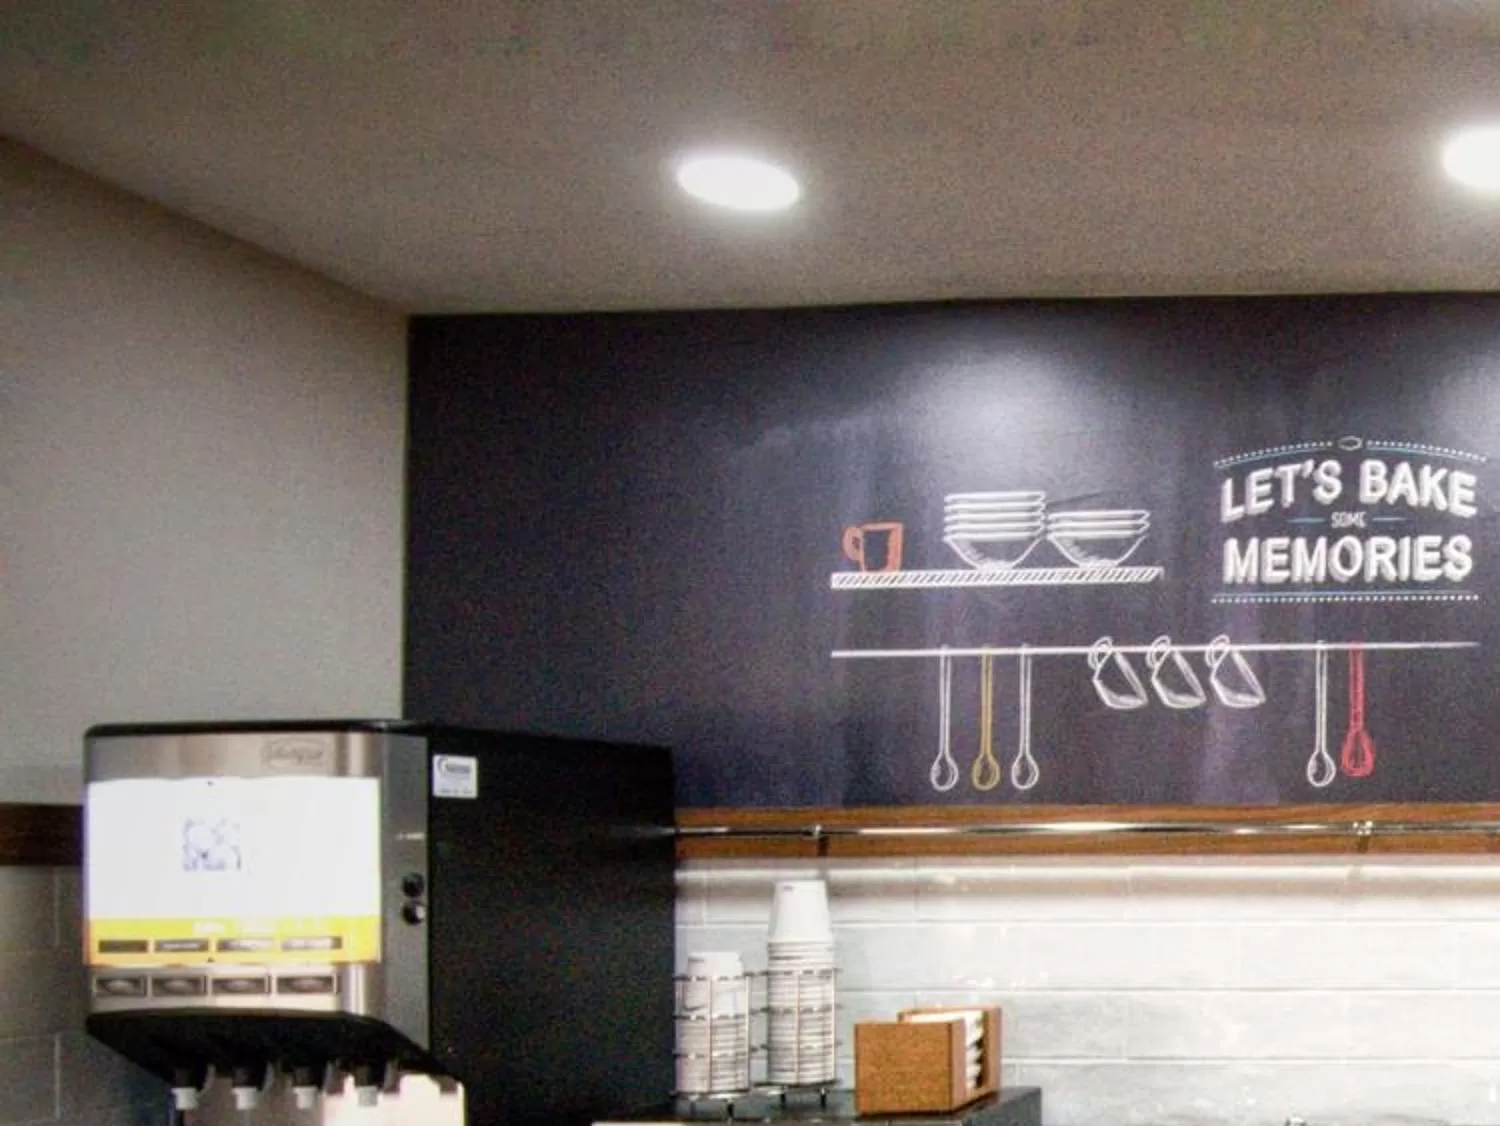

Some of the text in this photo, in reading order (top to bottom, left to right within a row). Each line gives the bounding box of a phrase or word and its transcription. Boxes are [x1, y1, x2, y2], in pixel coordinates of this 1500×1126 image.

[1220, 458, 1478, 523] LET'S BAKE
[1330, 511, 1367, 528] SOME
[1222, 534, 1474, 584] MEMORIES
